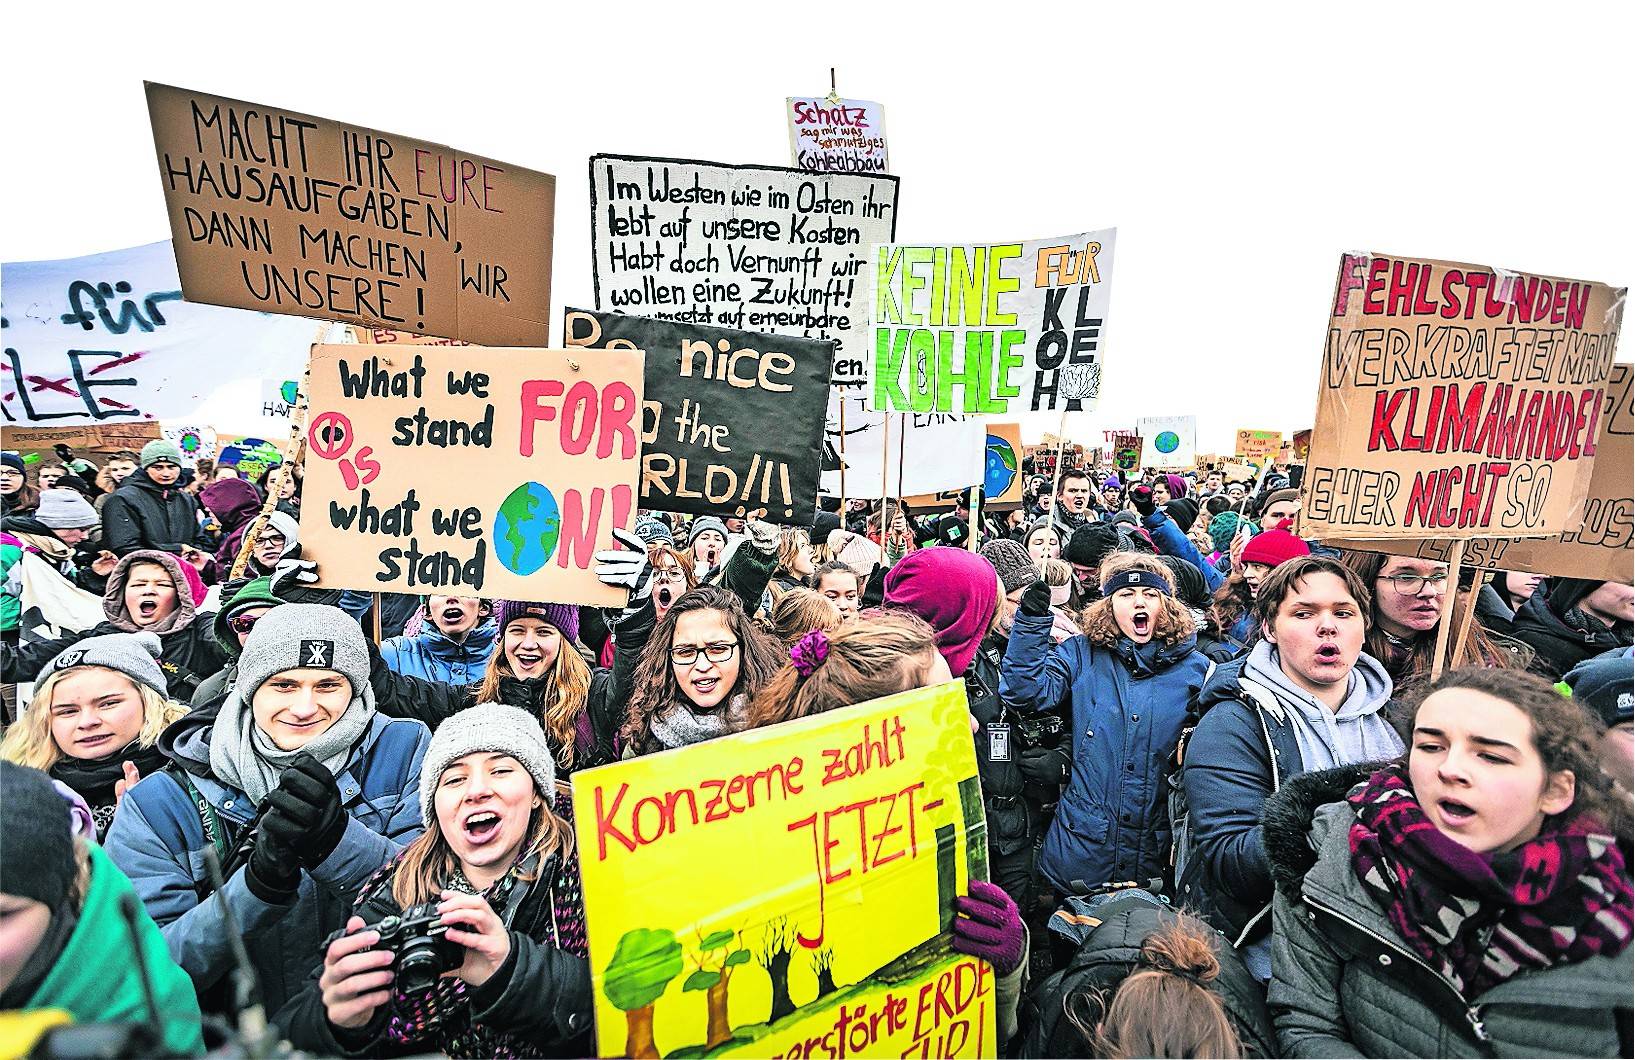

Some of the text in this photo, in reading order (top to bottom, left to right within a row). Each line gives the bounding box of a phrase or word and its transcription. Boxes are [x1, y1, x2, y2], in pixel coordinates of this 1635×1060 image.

[793, 101, 870, 128] Schatz
[800, 127, 820, 143] sag
[821, 125, 838, 136] mir
[190, 99, 504, 214] MACHT IHR EURE
[819, 136, 885, 155] schmutziges
[164, 153, 463, 254] HAUSAUFGABEN,
[607, 165, 892, 220] Im Westen wie im Osten ihr
[608, 203, 860, 249] lebt auf unsere Kosten
[184, 207, 511, 303] DANN MACHEN WIR
[609, 240, 868, 288] Habt doch Vernunft wir
[1034, 241, 1102, 288] FÜR
[60, 280, 184, 335] für
[610, 275, 855, 312] wollen eine Zukunft!
[876, 243, 1024, 327] KEINE
[1333, 253, 1592, 330] FEHLSTUNDEN
[717, 302, 746, 329] auf
[338, 355, 490, 399] What we
[679, 338, 796, 393] nice
[874, 327, 1027, 414] KOHLE
[1328, 323, 1618, 389] VERKRAFTET MAN
[1, 347, 141, 422] LE
[391, 380, 637, 460] stand FOR
[674, 398, 732, 453] the
[1367, 380, 1605, 462] KLIMAWANDEL
[329, 488, 421, 537] what
[431, 506, 484, 540] we
[1307, 461, 1553, 529] EHER NICHT SO.
[375, 537, 487, 591] stand
[594, 715, 906, 861] Konzerne zahlt
[771, 958, 991, 1060] erstörte ERDE
